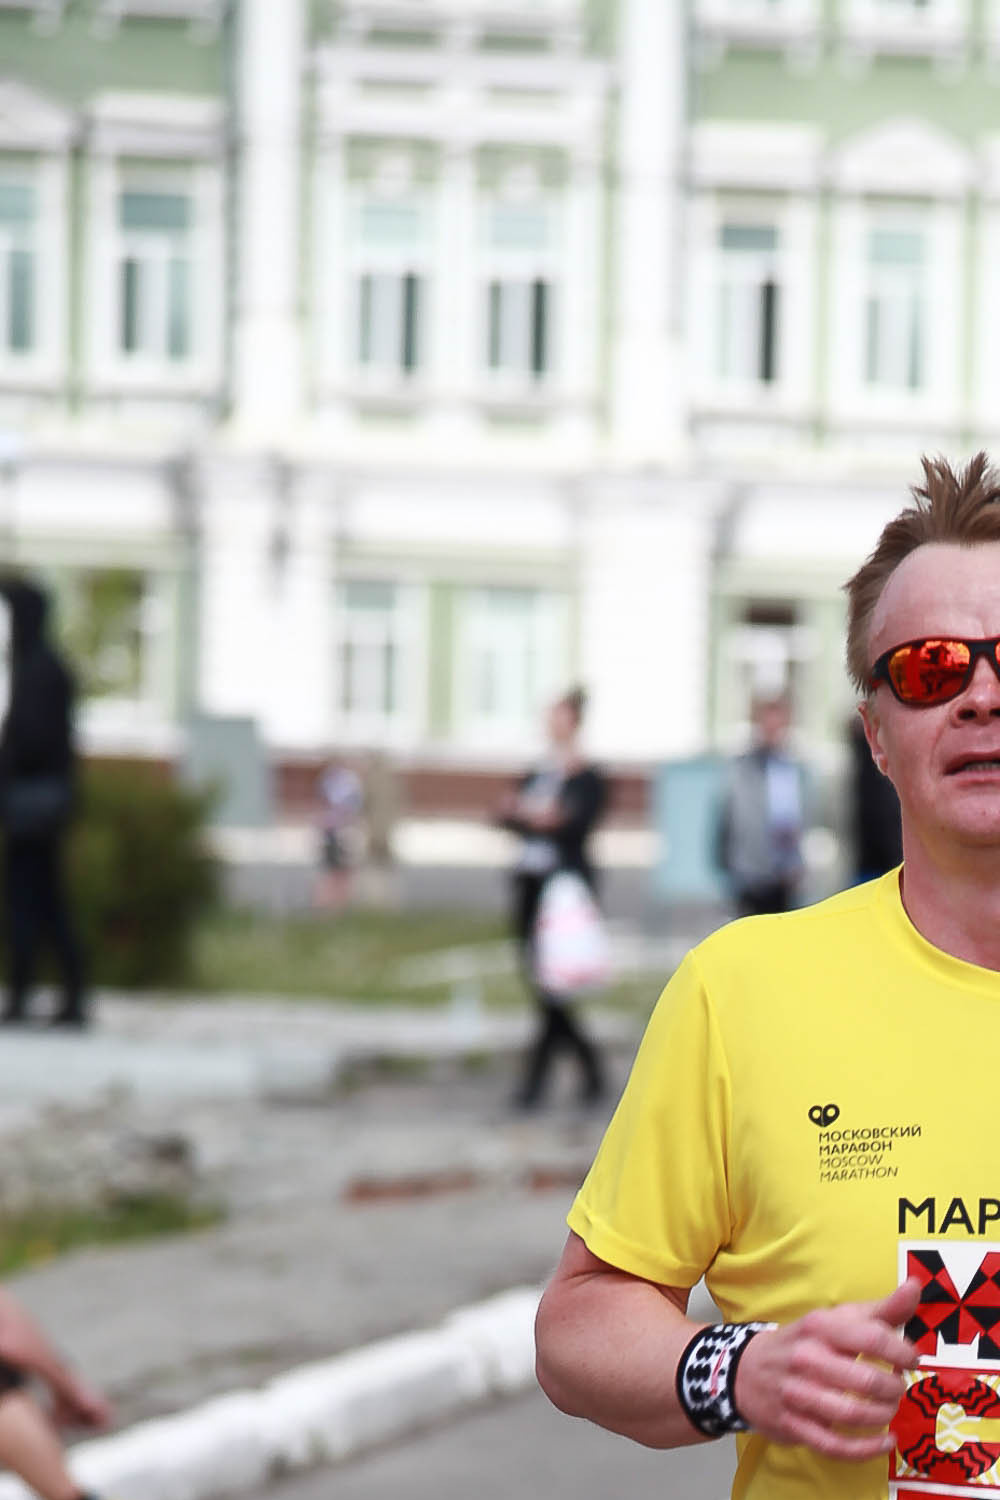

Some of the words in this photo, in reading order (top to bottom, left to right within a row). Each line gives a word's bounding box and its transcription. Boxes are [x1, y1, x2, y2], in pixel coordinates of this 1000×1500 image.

[819, 1125, 922, 1143] МОСКОВСКИЙ
[819, 1140, 892, 1156] МАРАФОН
[819, 1155, 884, 1169] MOSCOW
[819, 1166, 899, 1183] MARATHON
